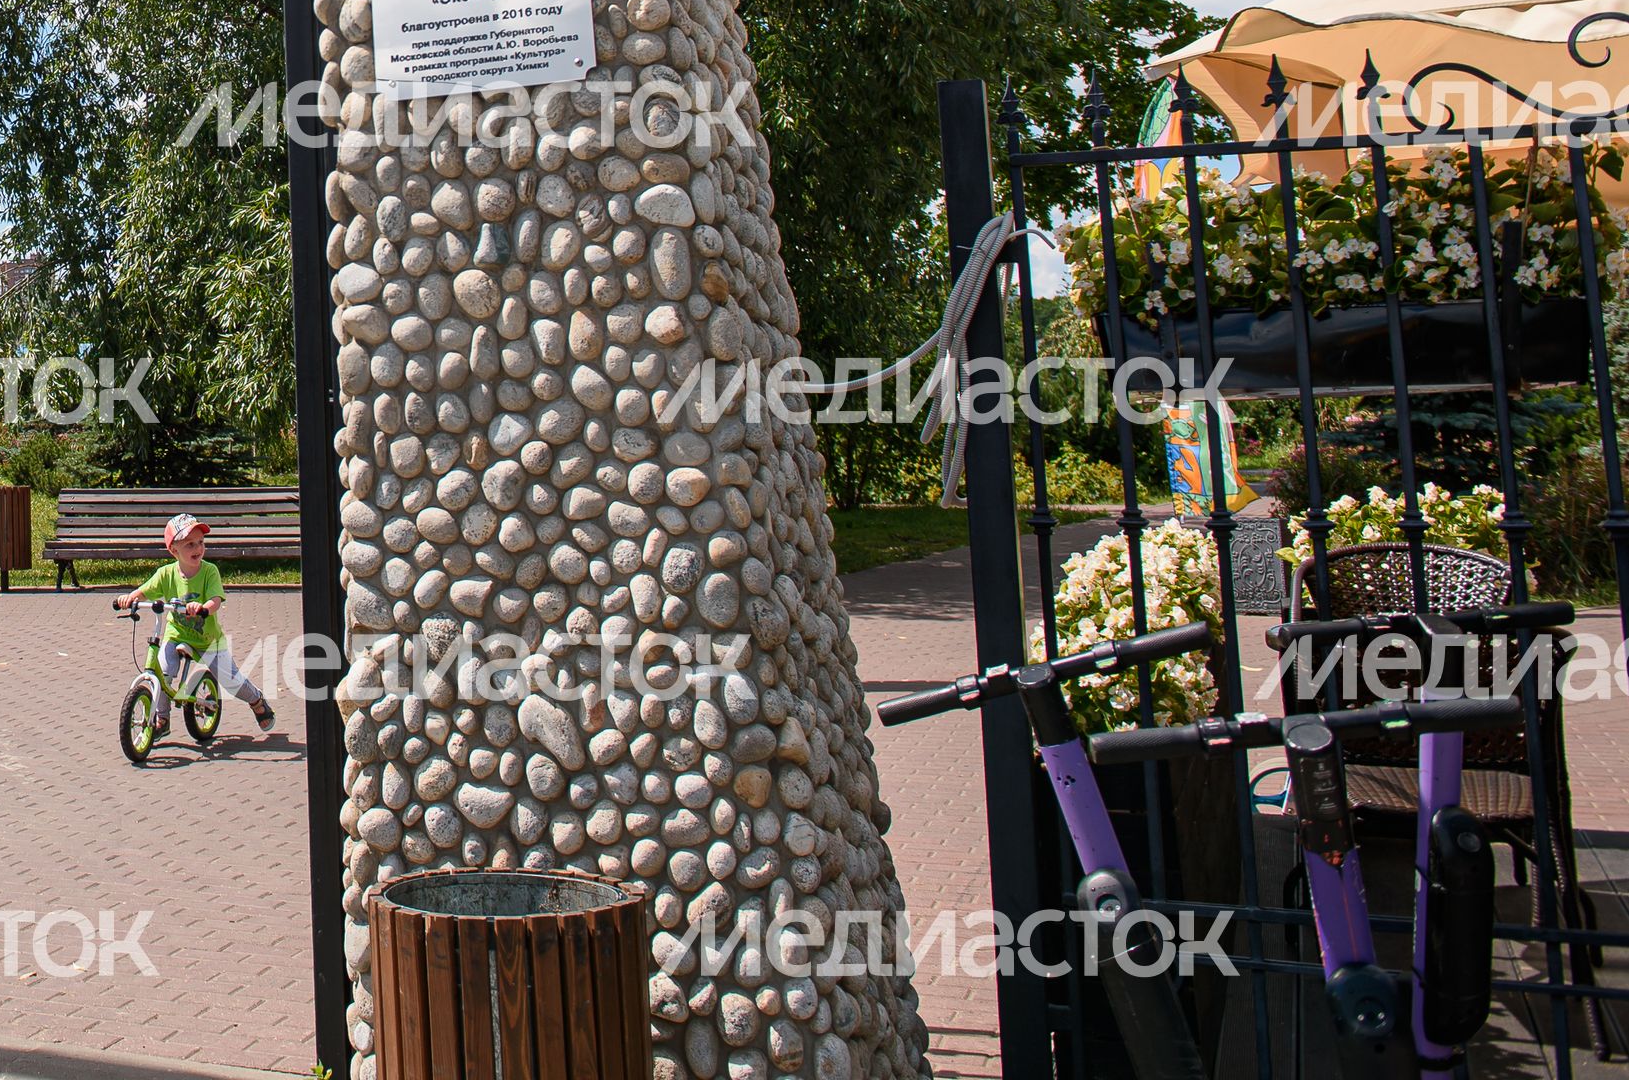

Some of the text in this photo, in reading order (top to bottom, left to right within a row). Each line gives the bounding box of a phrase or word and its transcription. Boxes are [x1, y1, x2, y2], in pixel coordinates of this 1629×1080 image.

[401, 14, 490, 33] благоустроена
[502, 7, 532, 20] 2016
[535, 5, 563, 16] году
[412, 25, 554, 50] при поддержке Губернатора
[391, 48, 450, 63] Московской
[452, 44, 493, 56] области
[412, 61, 448, 74] рамках
[449, 54, 508, 68] программы
[510, 48, 566, 61] «Культура»
[421, 61, 549, 83] городского округа Химки
